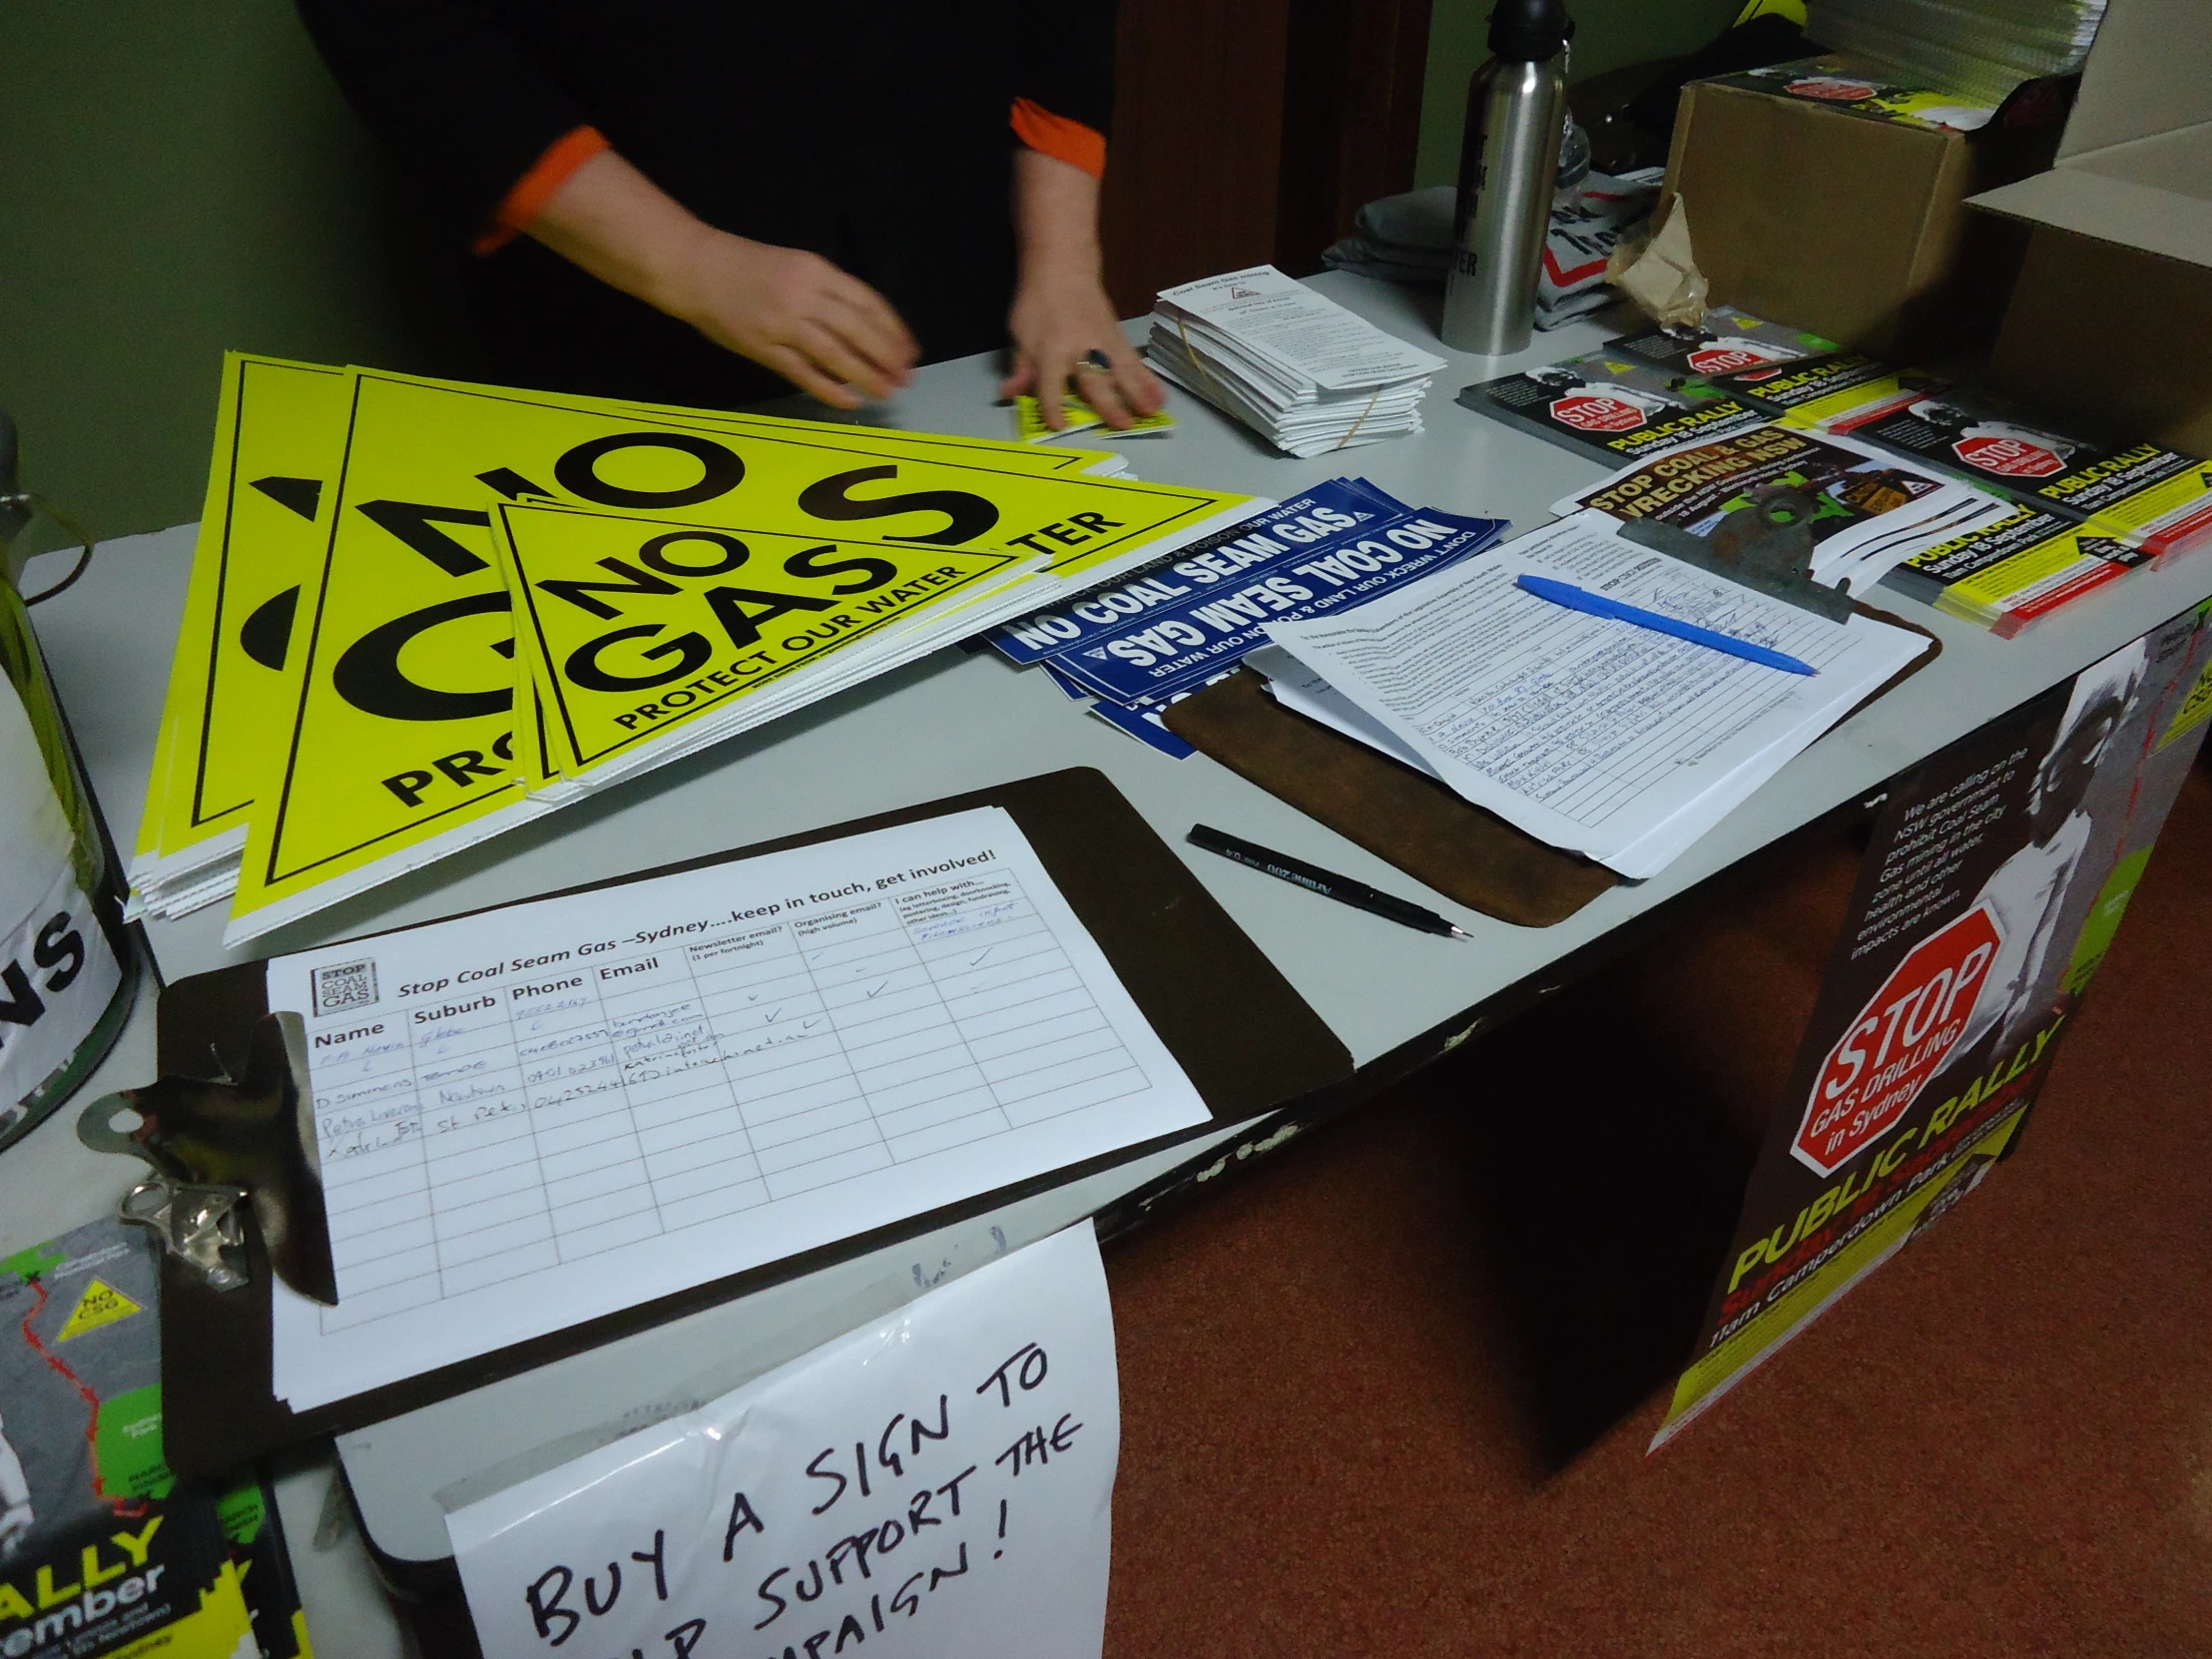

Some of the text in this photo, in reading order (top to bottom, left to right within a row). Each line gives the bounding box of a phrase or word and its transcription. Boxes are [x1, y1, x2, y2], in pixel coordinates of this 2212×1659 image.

[1173, 285, 1194, 296] Coal
[1747, 371, 1820, 398] PUBLIC
[1556, 397, 1618, 423] STOP
[1606, 420, 1684, 451] PUBLIC
[1679, 400, 1745, 429] RALLY
[1692, 409, 1759, 435] September
[1589, 474, 1653, 511] STOP
[1654, 450, 1721, 478] COAL
[1720, 443, 1740, 455] &
[1737, 428, 1786, 448] GAS
[1752, 436, 1808, 463] NSW
[1964, 439, 2028, 467] STOP
[2037, 442, 2162, 499] PUBLIC RALLY
[2061, 451, 2180, 506] Sunday September
[1005, 510, 1126, 555] TER
[1099, 570, 1132, 588] OUR
[1190, 526, 1241, 554] POISON
[1239, 516, 1273, 532] OUR
[1268, 498, 1317, 521] WATER
[1386, 518, 1459, 550] NO
[1903, 527, 1980, 569] PUBLIC
[1923, 542, 1978, 575] Sunday
[1984, 512, 2056, 545] September
[537, 530, 751, 620] NO
[1000, 613, 1082, 651] NO
[1072, 576, 1192, 625] COAL
[1172, 532, 1291, 584] SEAM
[1272, 505, 1358, 543] GAS
[1292, 540, 1404, 587] COAL
[564, 543, 898, 693] GAS
[1148, 530, 1477, 678] DON'T WRECK OUR LAND & OUR WATER
[1189, 576, 1314, 634] SEAM
[613, 650, 778, 731] PROTECT
[781, 613, 864, 652] OUR
[854, 565, 968, 615] WATER
[1106, 620, 1207, 667] GAS
[1893, 770, 2016, 843] NSW government to
[1904, 748, 2028, 822] We are calling on the
[1880, 805, 2008, 882] Gas mining in the city
[1885, 794, 2000, 866] prohibit Coal Seam
[901, 893, 922, 903] can
[923, 886, 948, 898] help
[1267, 862, 1292, 880] 200
[1863, 859, 1963, 922] health and other
[1872, 878, 1904, 903] zone
[1905, 860, 1933, 884] until
[1933, 849, 1950, 868] all
[398, 848, 997, 998] Stop Coal Seam Gas in touch, get involved!
[794, 900, 883, 928] Organising email?
[798, 915, 858, 936] (high volume)
[906, 915, 927, 925] other
[1851, 924, 1900, 961] impacts
[1901, 912, 1922, 931] are
[1857, 882, 1944, 941] environmental
[689, 924, 784, 953] Newsletter email?
[703, 948, 720, 960] per
[720, 937, 765, 954] fortnight)
[321, 963, 366, 980] STOP
[321, 973, 367, 989] COAL
[321, 981, 367, 998] SEAM
[512, 976, 584, 1000] Phone
[599, 957, 660, 980] Email
[322, 989, 370, 1008] GAS
[414, 995, 496, 1024] Suburb
[1825, 941, 1993, 1100] STOP
[314, 1023, 385, 1049] Name
[1810, 1017, 1961, 1138] GAS DRILLING
[1825, 1127, 1846, 1156] in
[1849, 1074, 1923, 1137] Sydney
[1727, 1127, 1919, 1295] PUBLIC
[1917, 1014, 2067, 1151] RALLY
[1710, 1301, 1761, 1348] 11am
[1766, 1189, 1903, 1303] Camperdown
[1906, 1151, 1950, 1193] Park
[83, 1289, 114, 1308] NO
[527, 1529, 668, 1647] BUY
[722, 1491, 764, 1563] A
[806, 1393, 950, 1515] SIGN
[976, 1342, 1049, 1407] TO
[754, 1412, 1084, 1631] SUPPORT THE
[0, 1514, 165, 1619] ALLY
